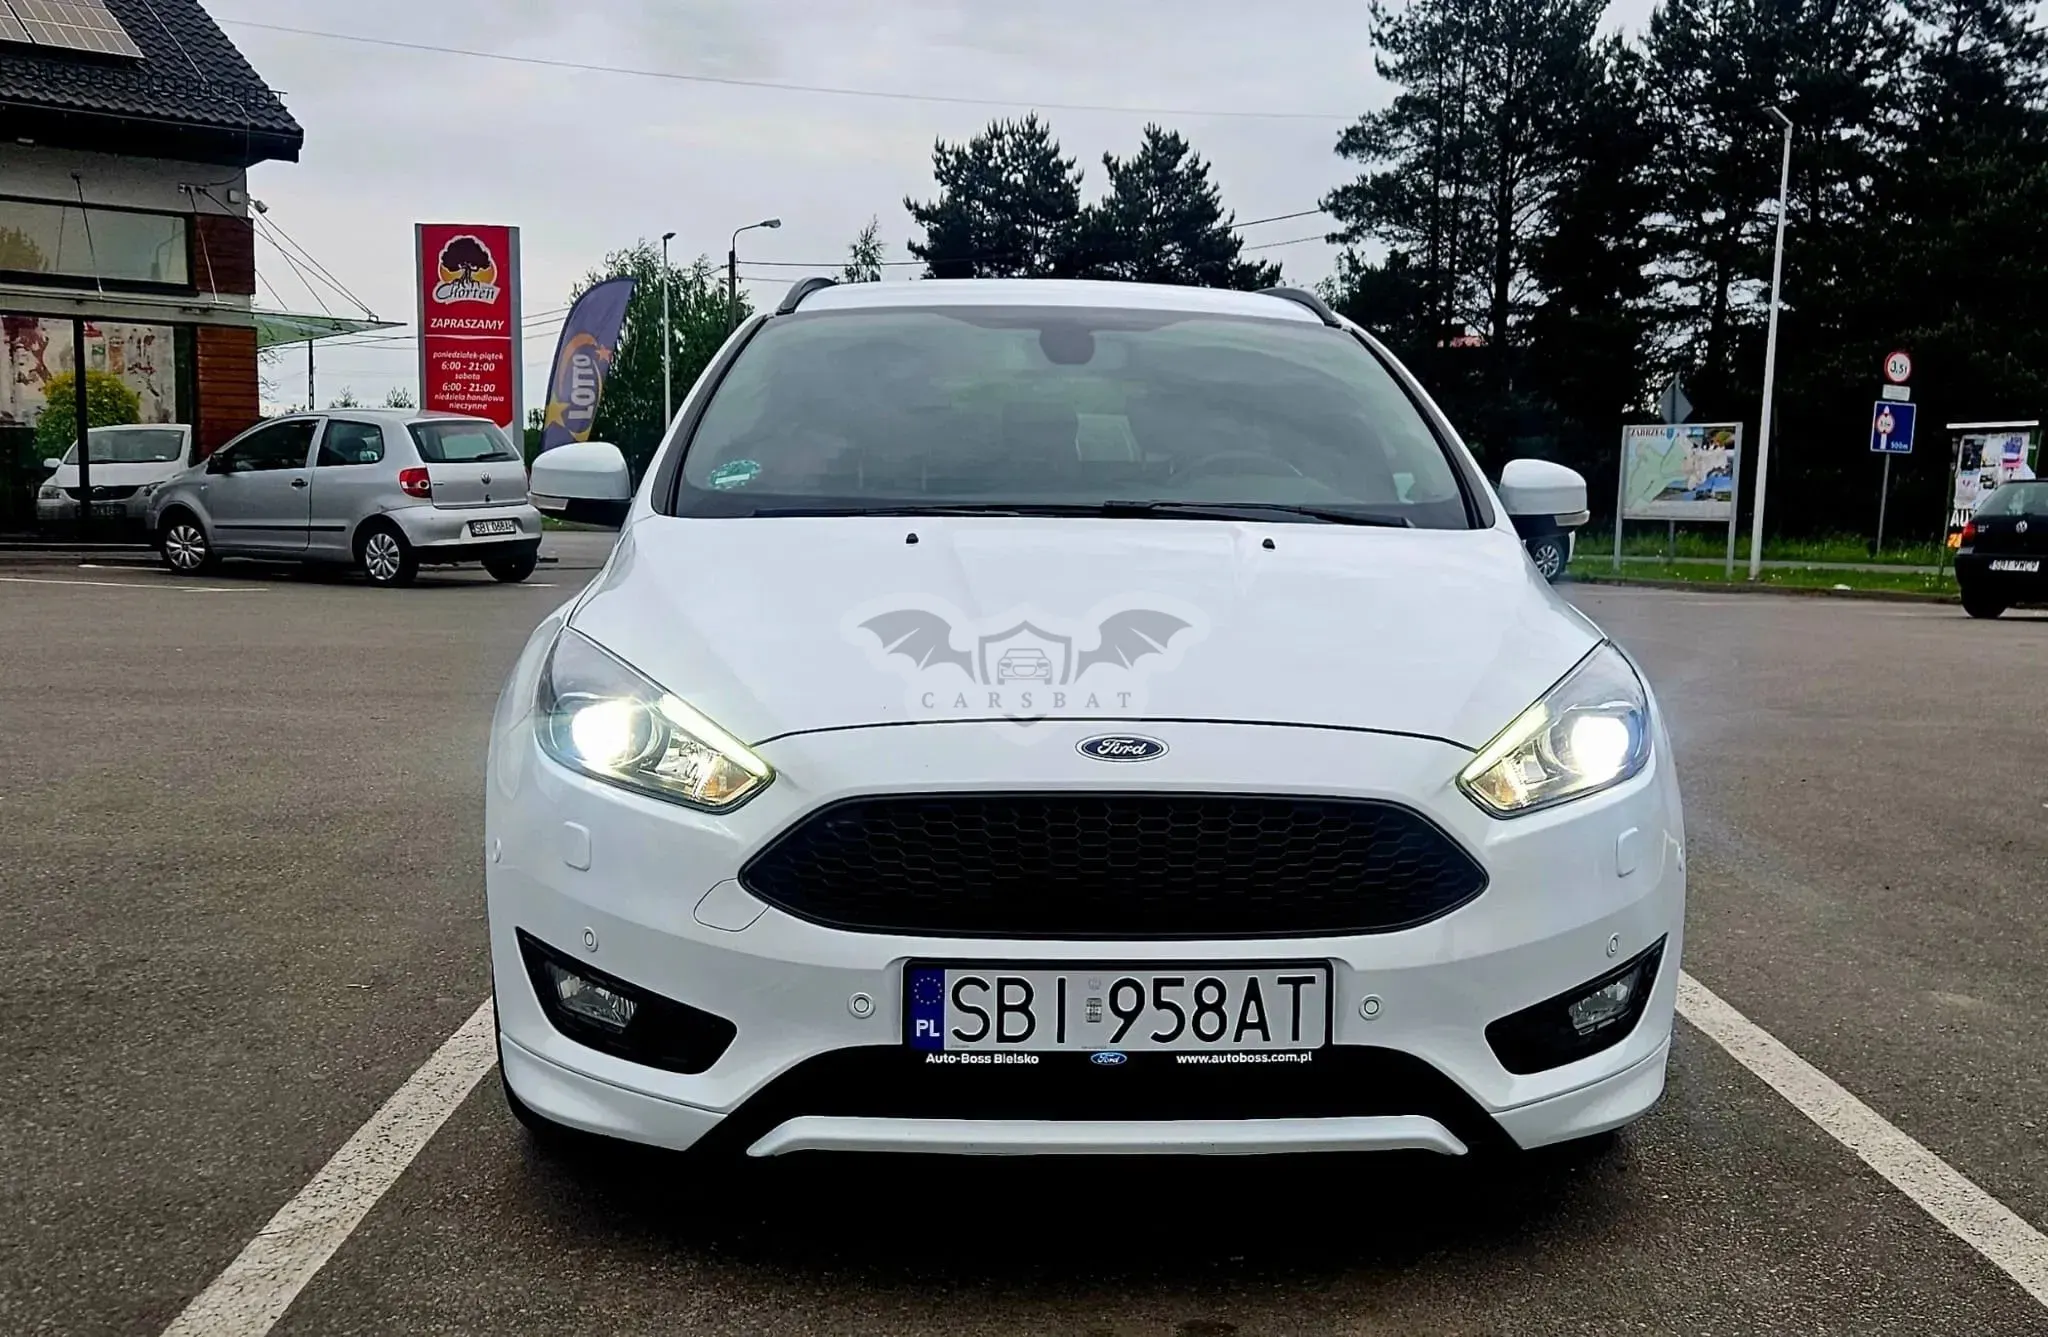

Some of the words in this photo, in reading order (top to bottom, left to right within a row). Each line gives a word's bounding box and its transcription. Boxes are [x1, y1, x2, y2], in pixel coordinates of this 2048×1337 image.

[436, 281, 494, 300] Chorten
[430, 318, 504, 330] ZAPRASZAMY
[441, 361, 461, 371] 6:00
[468, 361, 495, 371] 21:00
[455, 372, 480, 380] sobota
[442, 382, 462, 392] 6:00
[468, 382, 496, 392] 21:00
[568, 354, 596, 419] LOTTO
[434, 392, 466, 402] niedziela
[466, 392, 504, 403] handlowa
[449, 402, 488, 411] nieczynne
[1096, 737, 1147, 757] Ford
[916, 1019, 940, 1037] PL
[951, 976, 1067, 1044] SBI
[1107, 975, 1317, 1044] 958AT
[925, 1052, 991, 1064] Auto-Boss
[993, 1052, 1040, 1064] Bielsko
[1095, 1052, 1122, 1064] Ford
[1176, 1051, 1313, 1064] www.autoboss.com.pl
